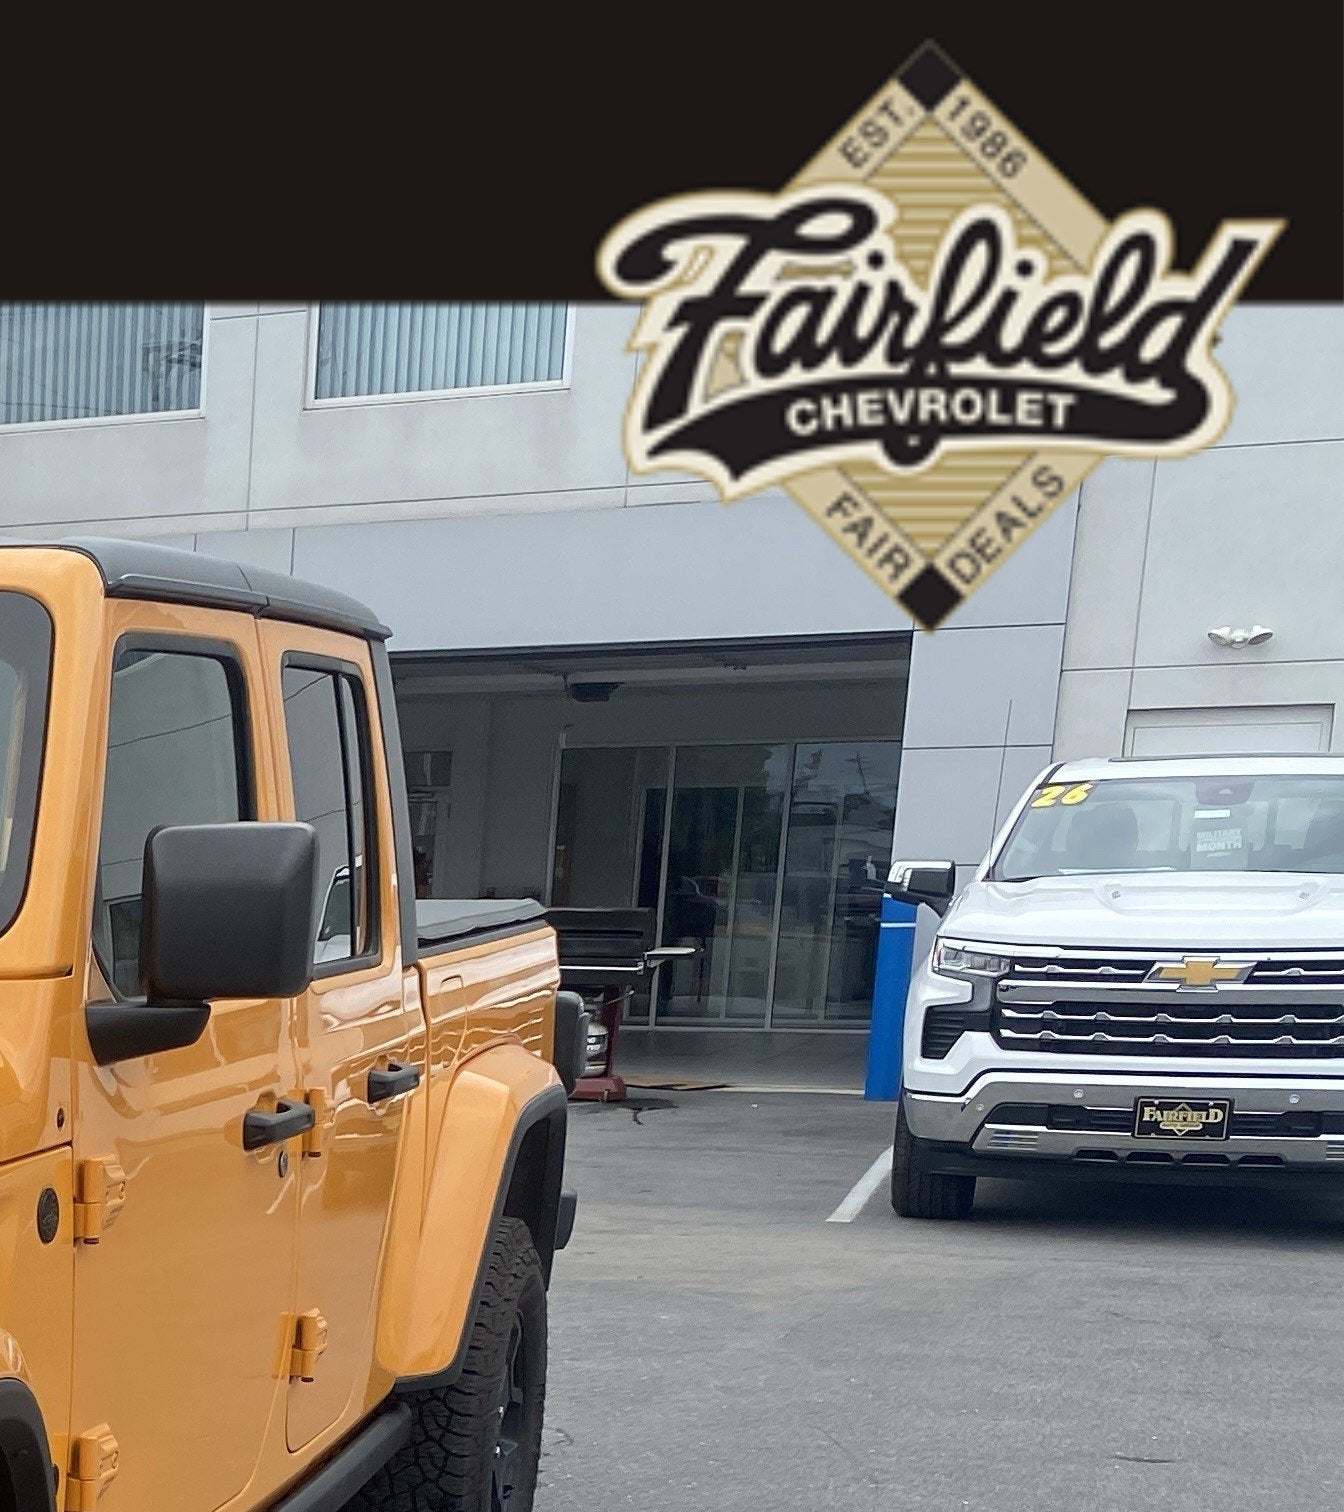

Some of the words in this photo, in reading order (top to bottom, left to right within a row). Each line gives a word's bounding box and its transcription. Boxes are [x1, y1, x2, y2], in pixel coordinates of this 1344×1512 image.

[1030, 783, 1094, 808] 26
[1196, 840, 1243, 852] MONTH
[1142, 1106, 1224, 1123] FAIRFIELD
